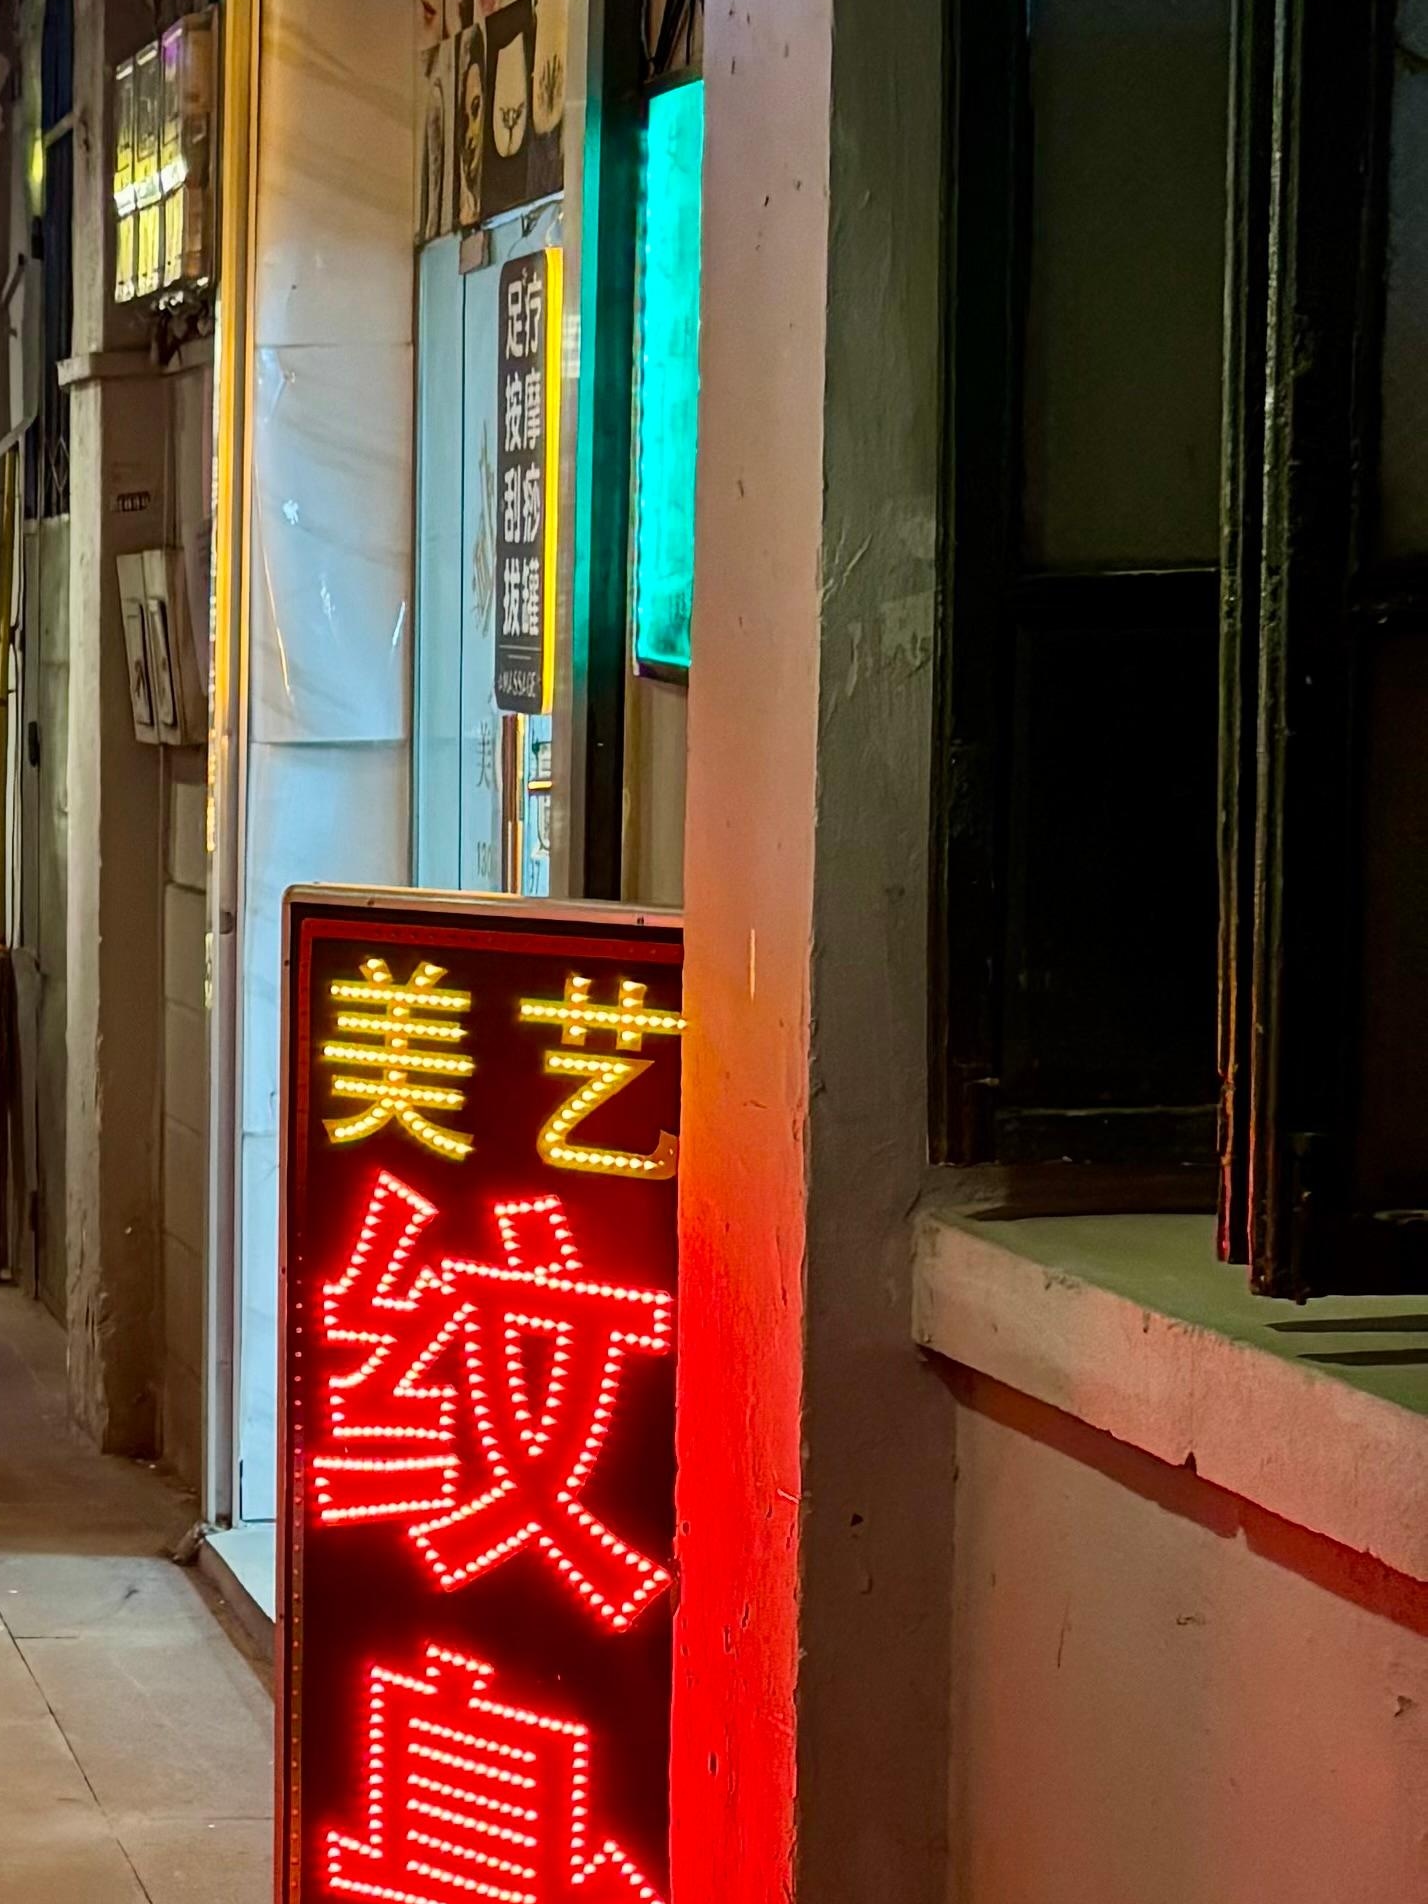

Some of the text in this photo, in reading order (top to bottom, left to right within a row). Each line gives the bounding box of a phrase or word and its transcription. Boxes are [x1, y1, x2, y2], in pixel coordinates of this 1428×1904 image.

[505, 271, 543, 360] 足疗
[504, 367, 541, 452] 按摩
[503, 462, 540, 543] 刮痧
[502, 557, 539, 636] 拔罐
[501, 669, 537, 698] MASSAGE
[321, 957, 688, 1181] 美艺
